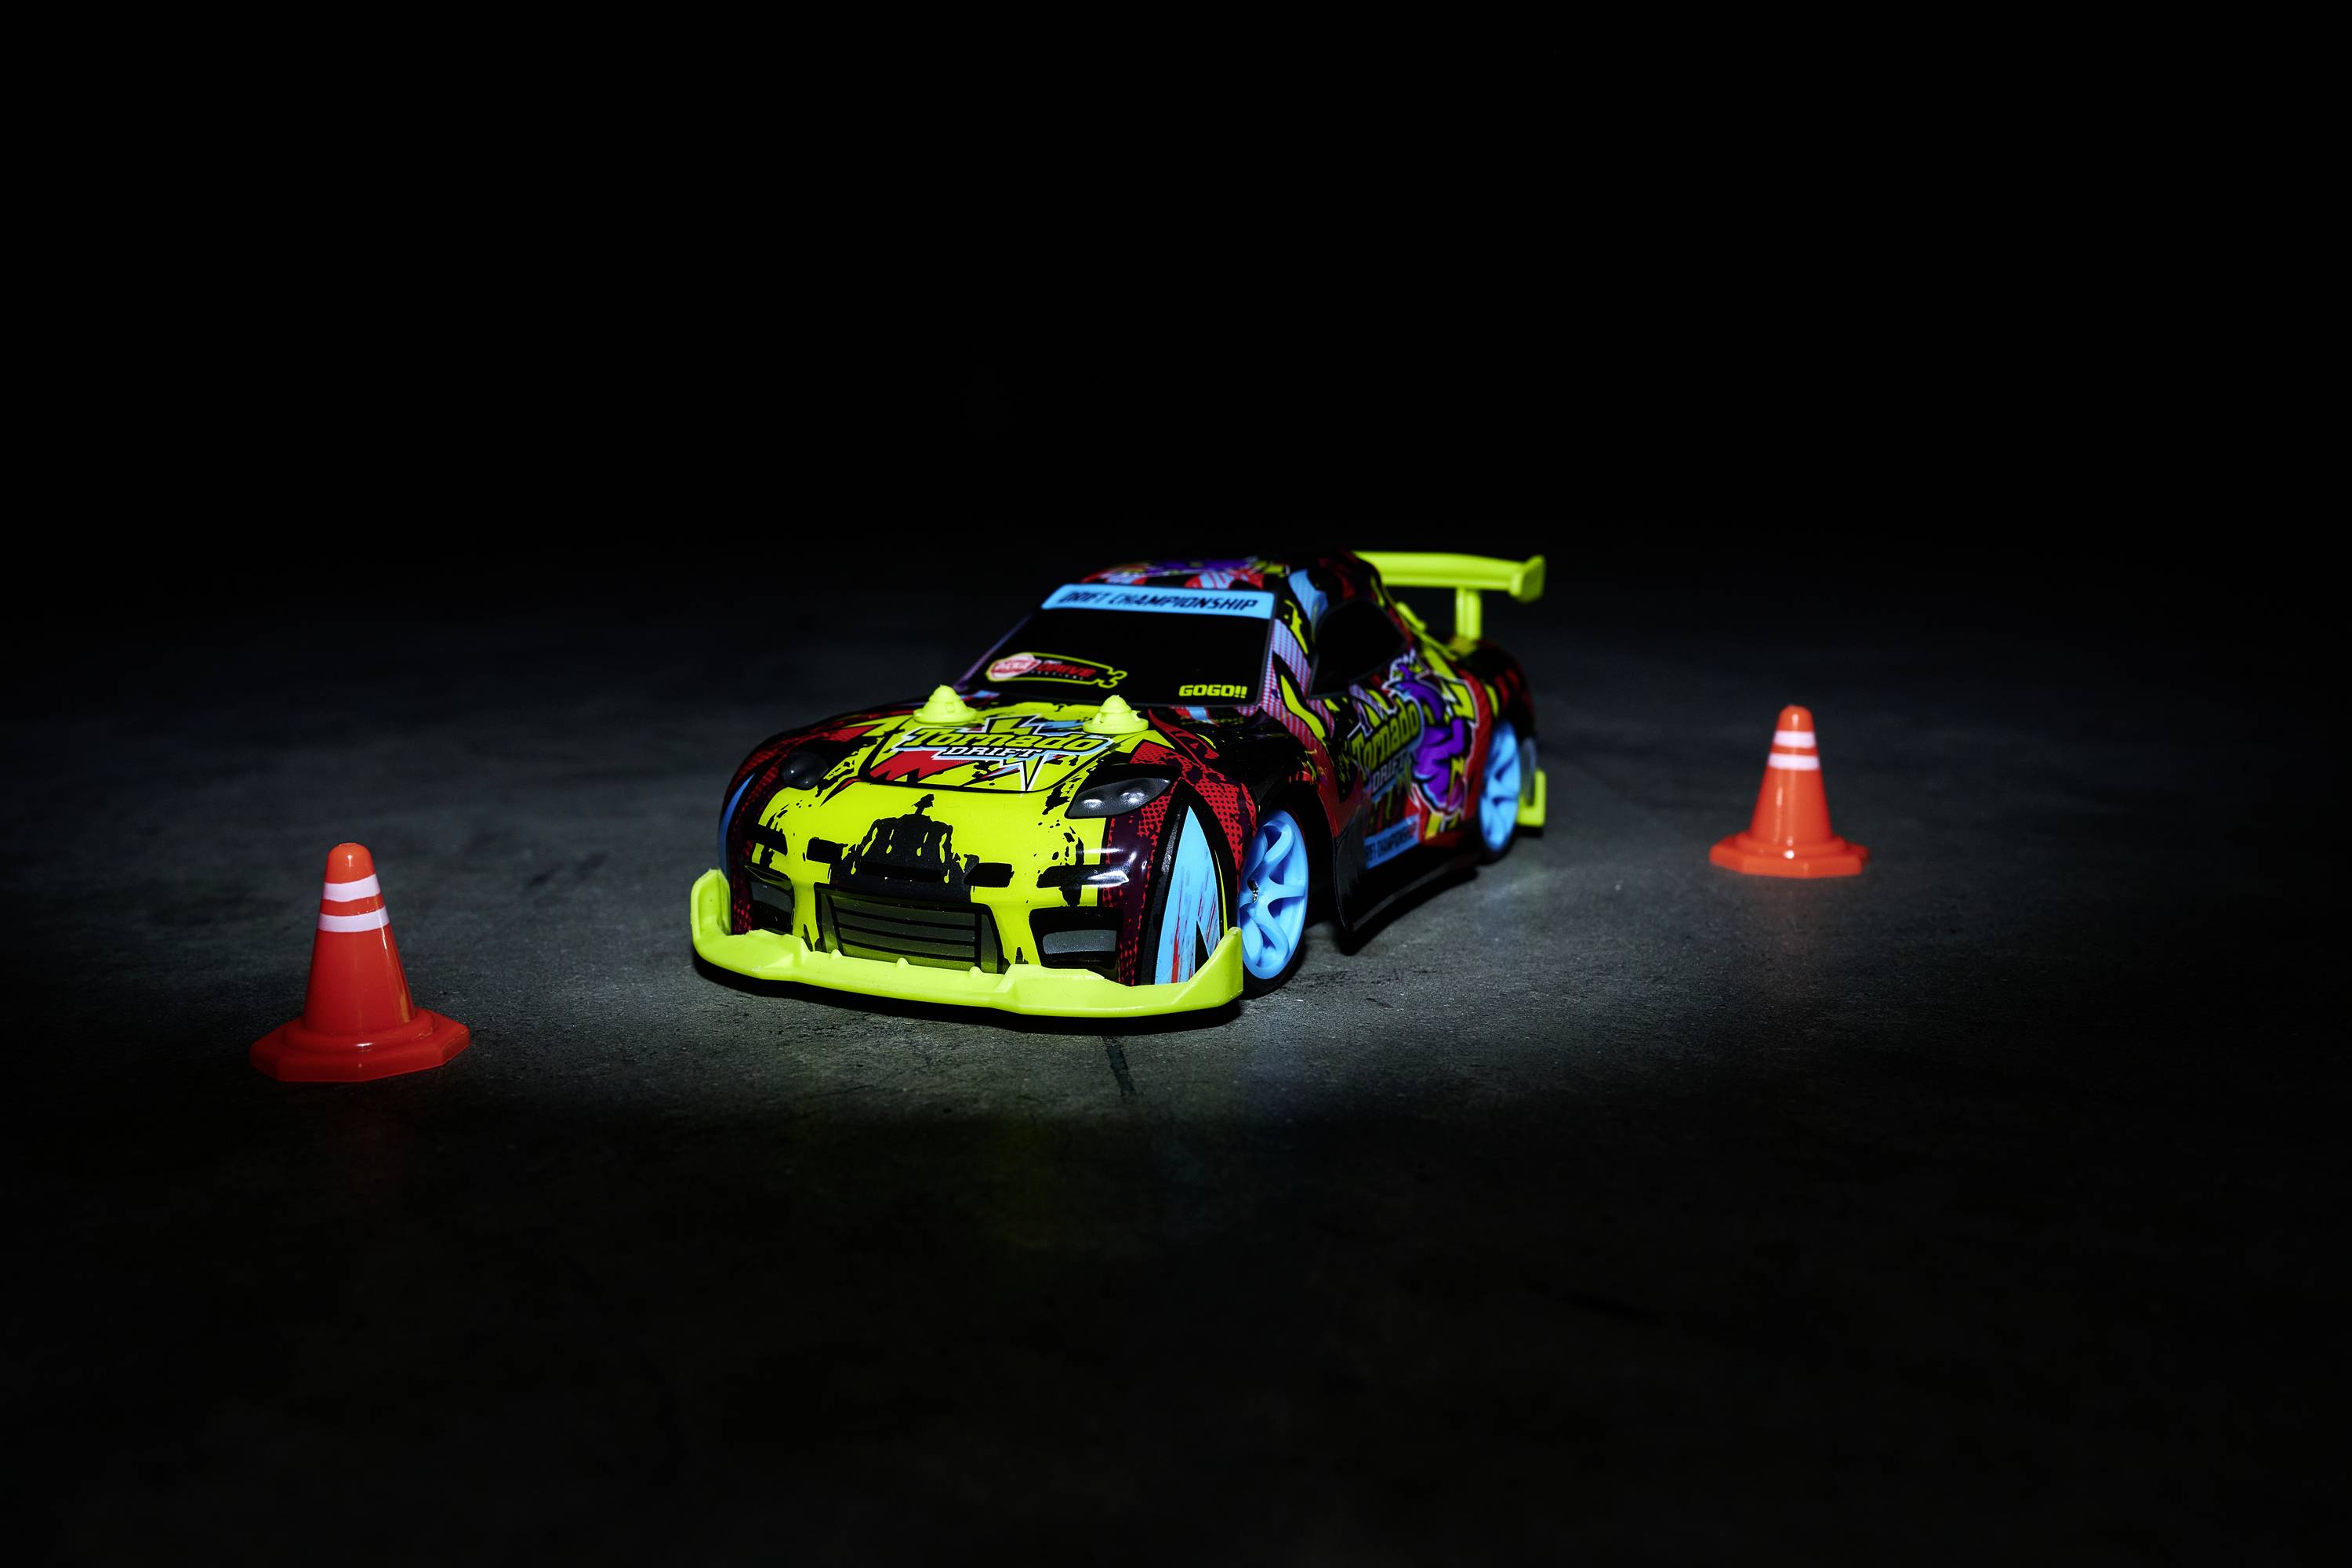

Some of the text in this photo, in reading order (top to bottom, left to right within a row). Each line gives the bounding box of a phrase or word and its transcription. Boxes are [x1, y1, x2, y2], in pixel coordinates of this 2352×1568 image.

[1058, 591, 1258, 611] DRIFT CHAMPIONSHIP
[1178, 684, 1248, 699] GOGO!!
[902, 728, 1105, 750] Tornado
[1350, 698, 1420, 772] Tornado
[943, 746, 1043, 758] DRIFT
